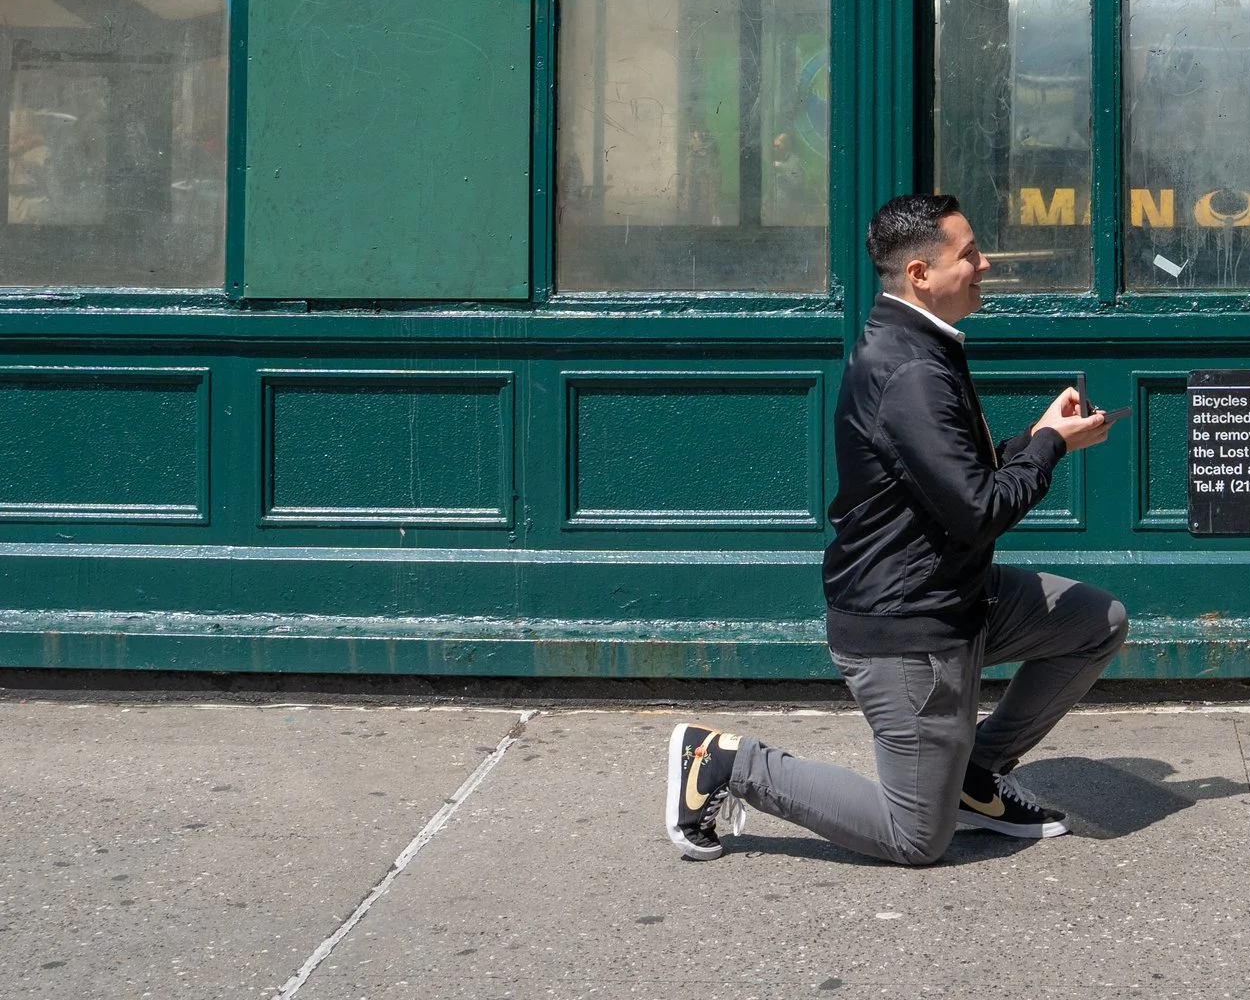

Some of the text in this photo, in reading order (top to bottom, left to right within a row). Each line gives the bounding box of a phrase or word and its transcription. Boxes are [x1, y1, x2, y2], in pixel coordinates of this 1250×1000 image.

[1192, 394, 1248, 409] Bicycles
[1193, 429, 1210, 441] be
[1193, 446, 1215, 458] the
[1219, 446, 1249, 458] Lost
[1193, 463, 1243, 475] located
[1194, 480, 1225, 492] Tel.#
